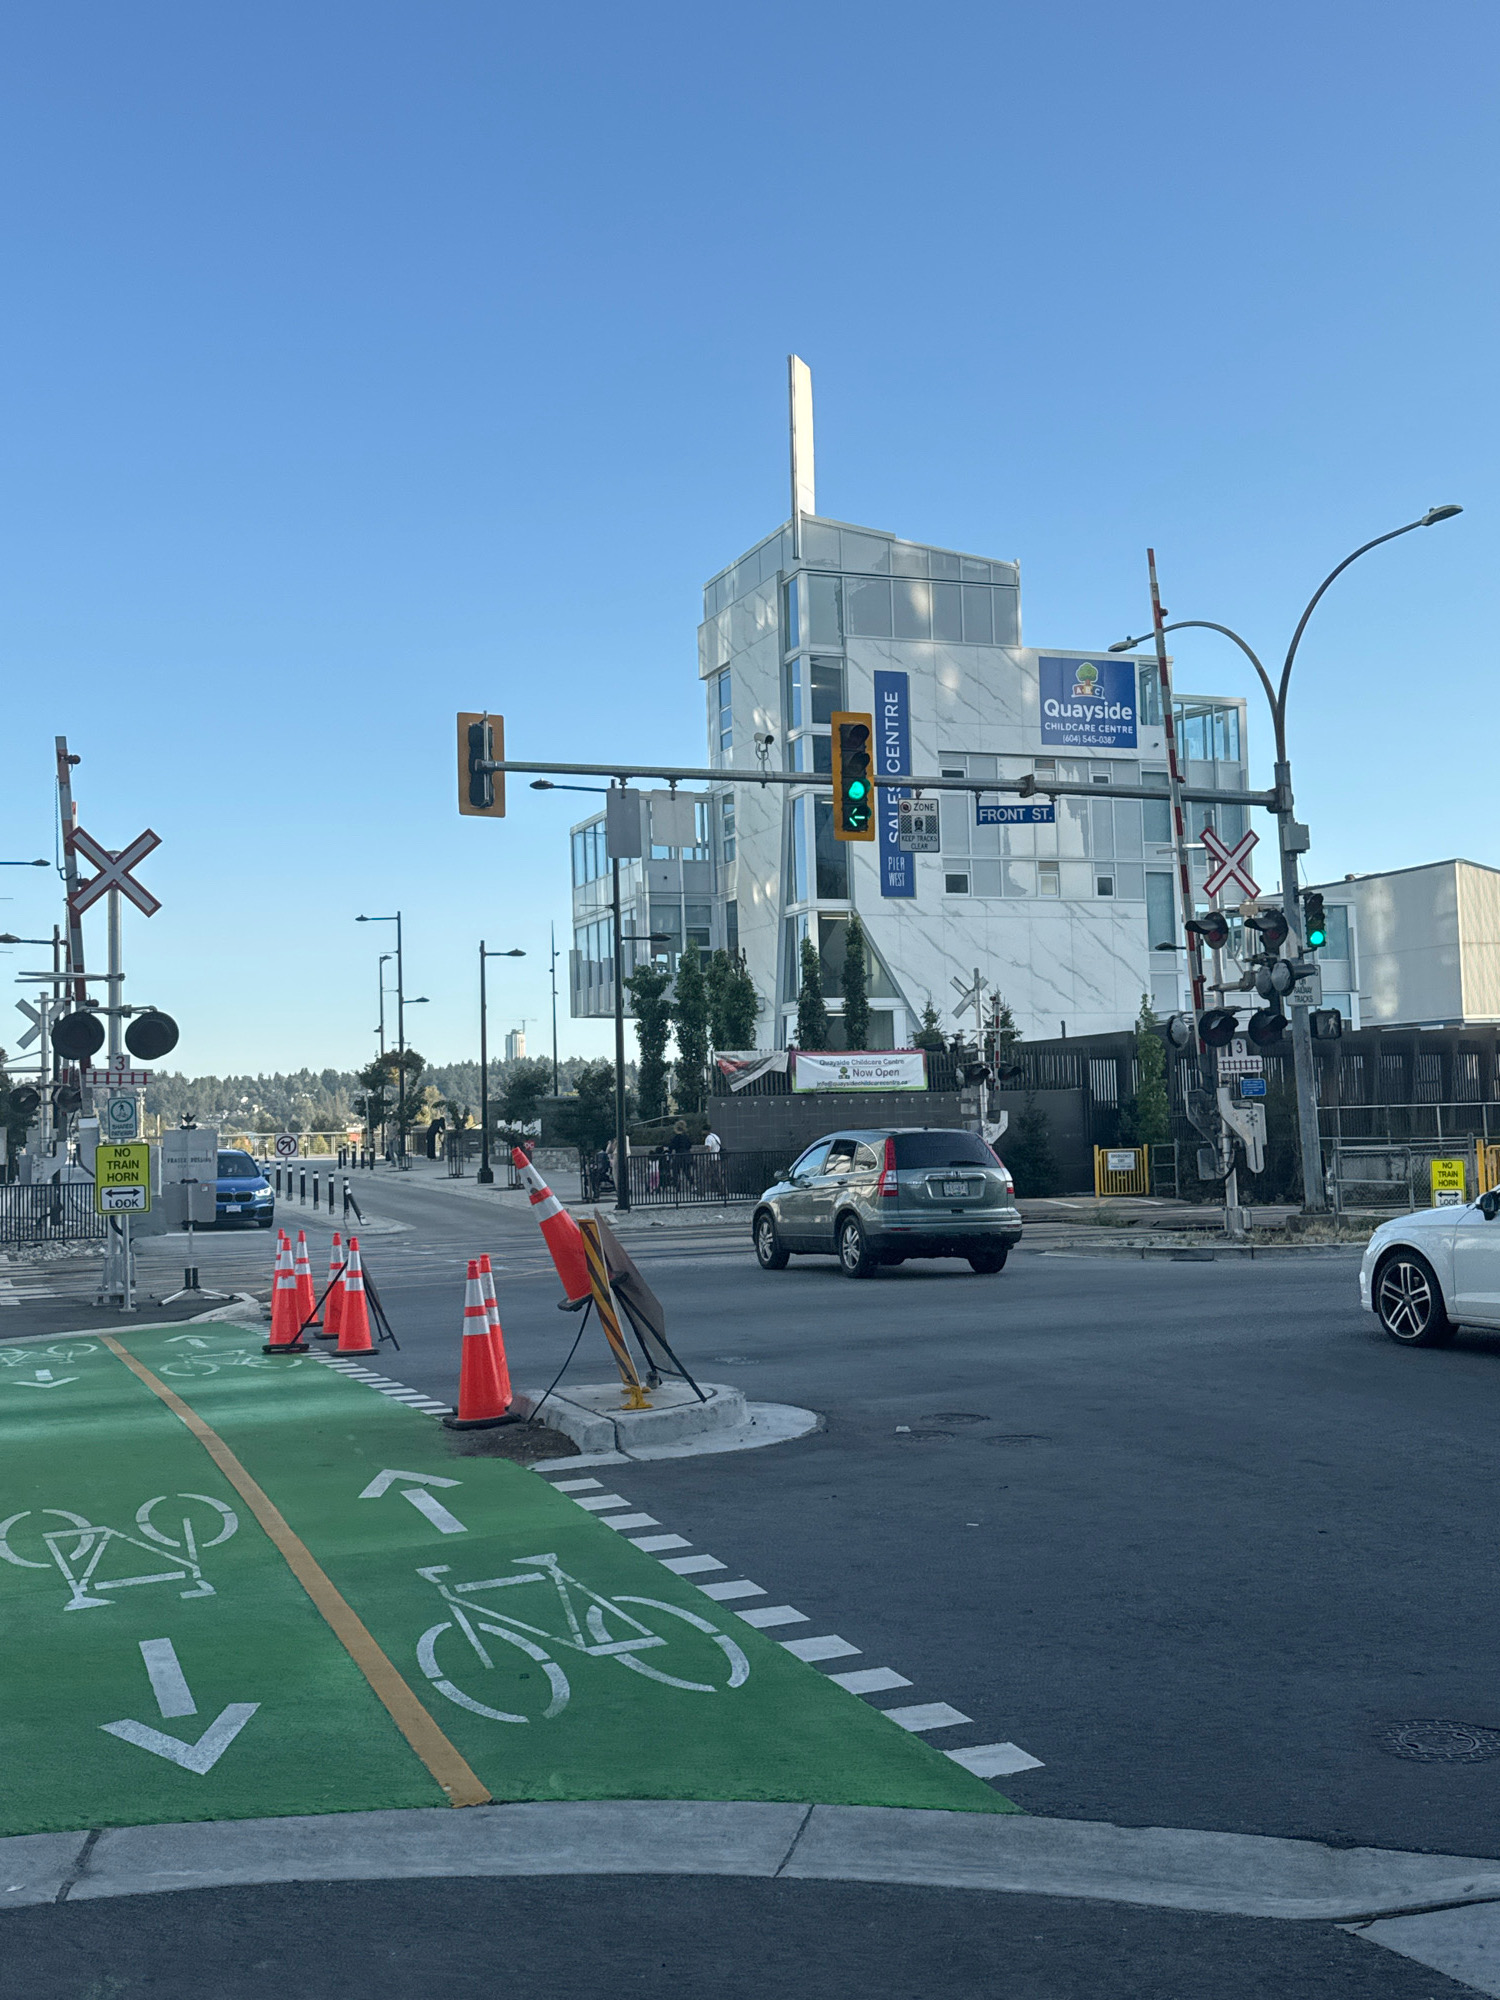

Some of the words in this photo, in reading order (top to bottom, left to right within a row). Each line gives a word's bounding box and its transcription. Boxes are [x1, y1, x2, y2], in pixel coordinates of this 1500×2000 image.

[1043, 698, 1133, 722] Quayside
[884, 691, 901, 773] CENTRE
[1044, 722, 1096, 732] CHILDCARE
[1098, 725, 1133, 734] CENTRE
[1062, 734, 1081, 744] (604)
[1082, 734, 1116, 744] 545-0387
[913, 803, 935, 812] ZONE
[979, 808, 1026, 822] FRONT
[1031, 807, 1053, 821] ST.
[901, 835, 916, 843] KEEP
[916, 834, 938, 842] TRACKS
[910, 842, 928, 850] CLEAR
[888, 856, 905, 871] PIER
[888, 872, 905, 887] WEST
[1236, 1041, 1243, 1053] 3
[114, 1055, 125, 1071] 3
[852, 1068, 873, 1078] Now
[875, 1067, 900, 1079] Open
[114, 1147, 131, 1158] NO
[106, 1160, 140, 1170] TRAIN
[106, 1172, 139, 1182] HORN
[108, 1199, 139, 1208] LOOK
